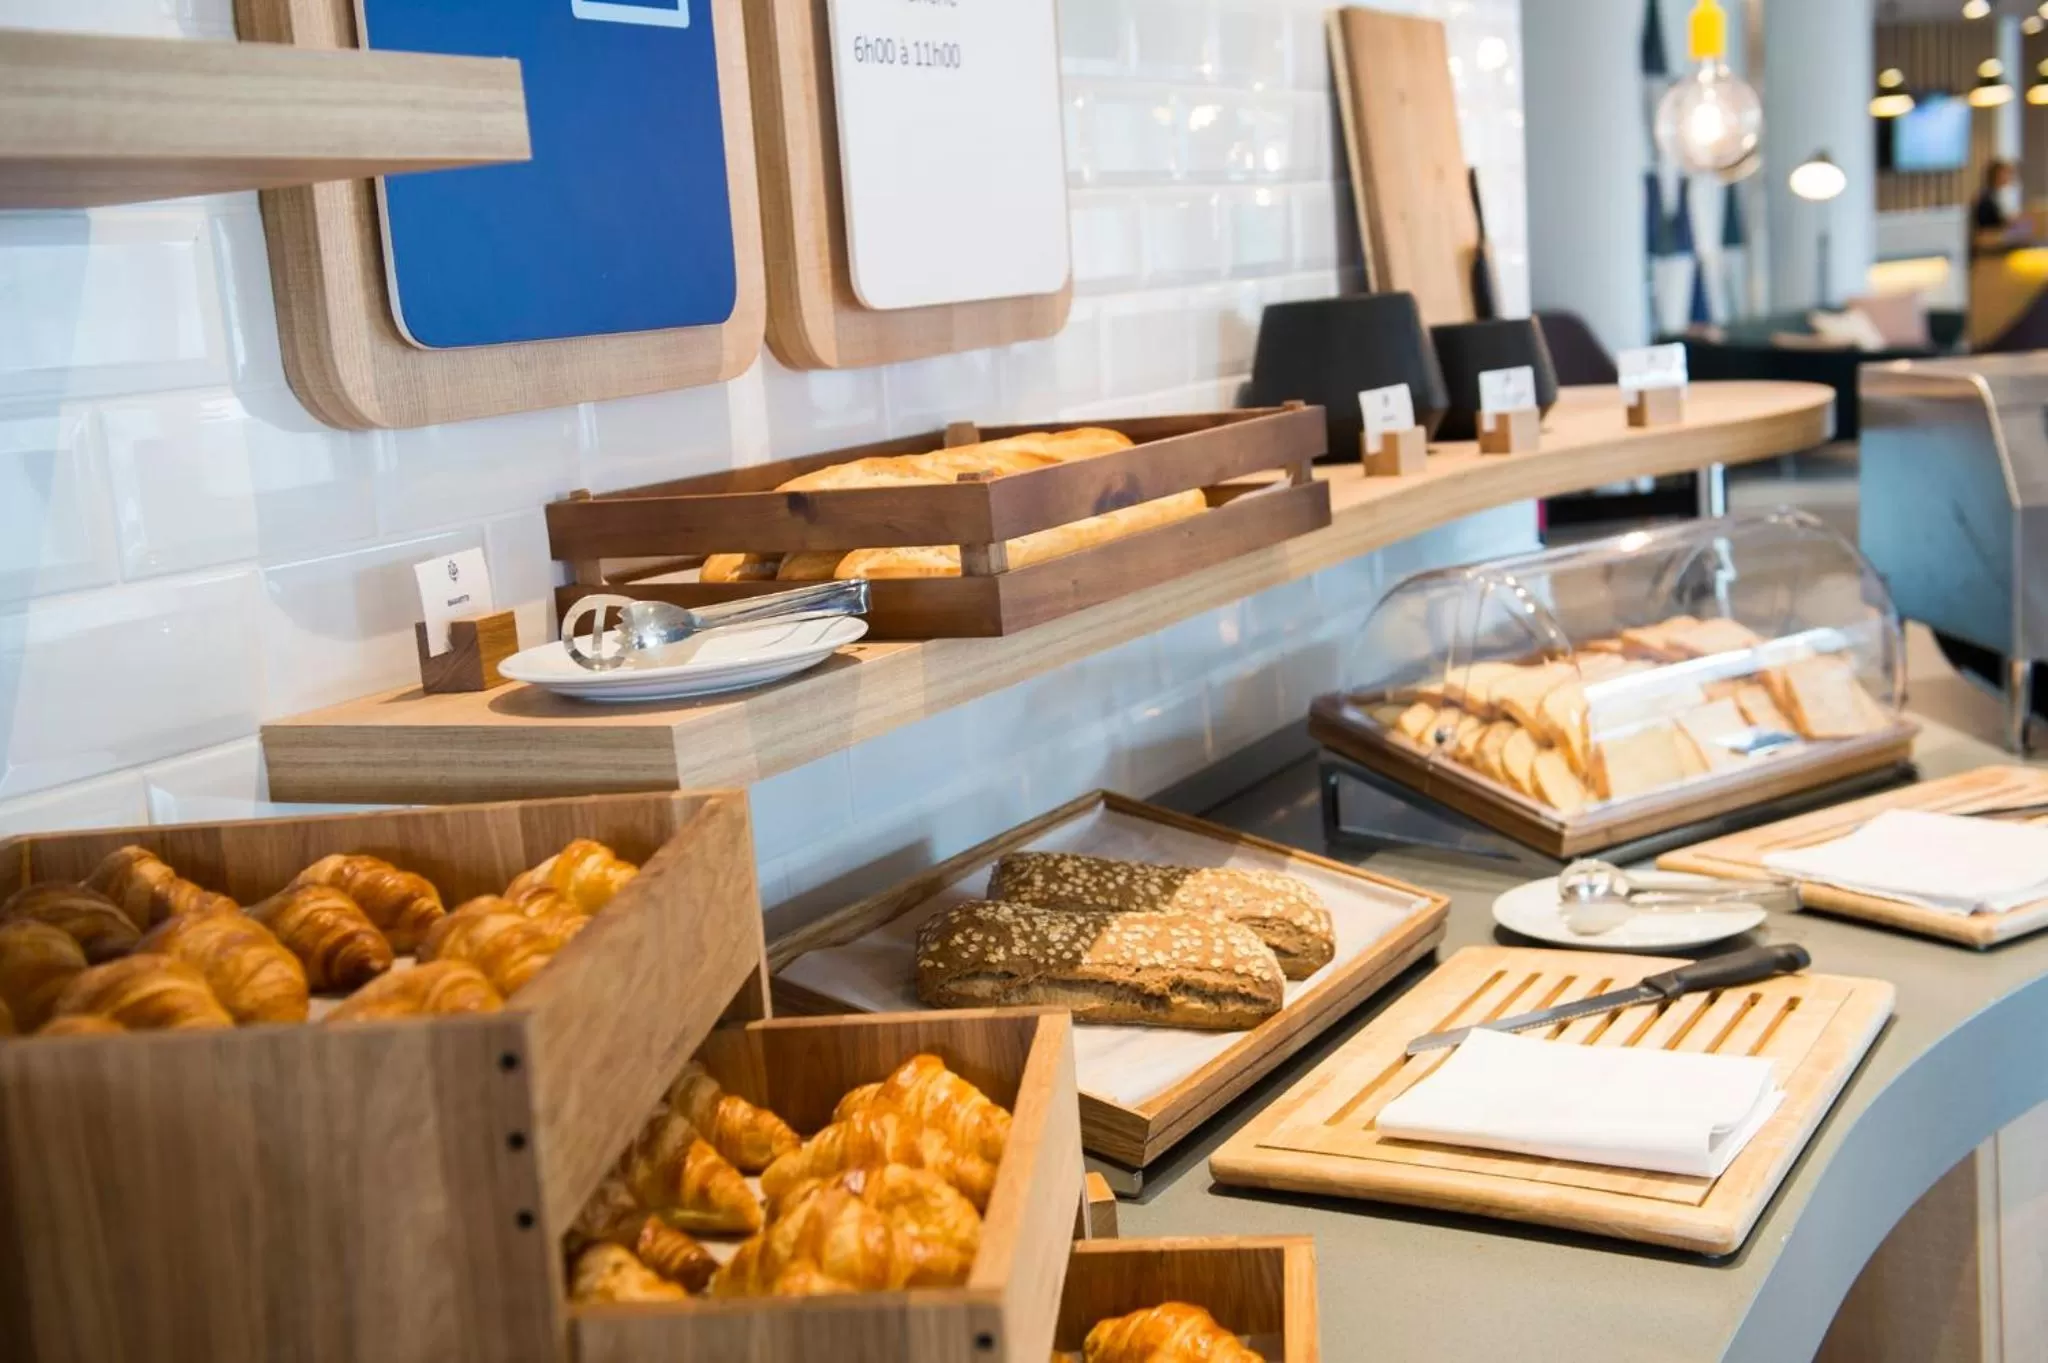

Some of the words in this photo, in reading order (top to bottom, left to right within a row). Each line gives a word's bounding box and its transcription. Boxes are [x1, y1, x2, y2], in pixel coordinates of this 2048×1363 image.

[854, 35, 896, 64] 6h00
[900, 36, 909, 66] à
[913, 41, 961, 69] 11h00
